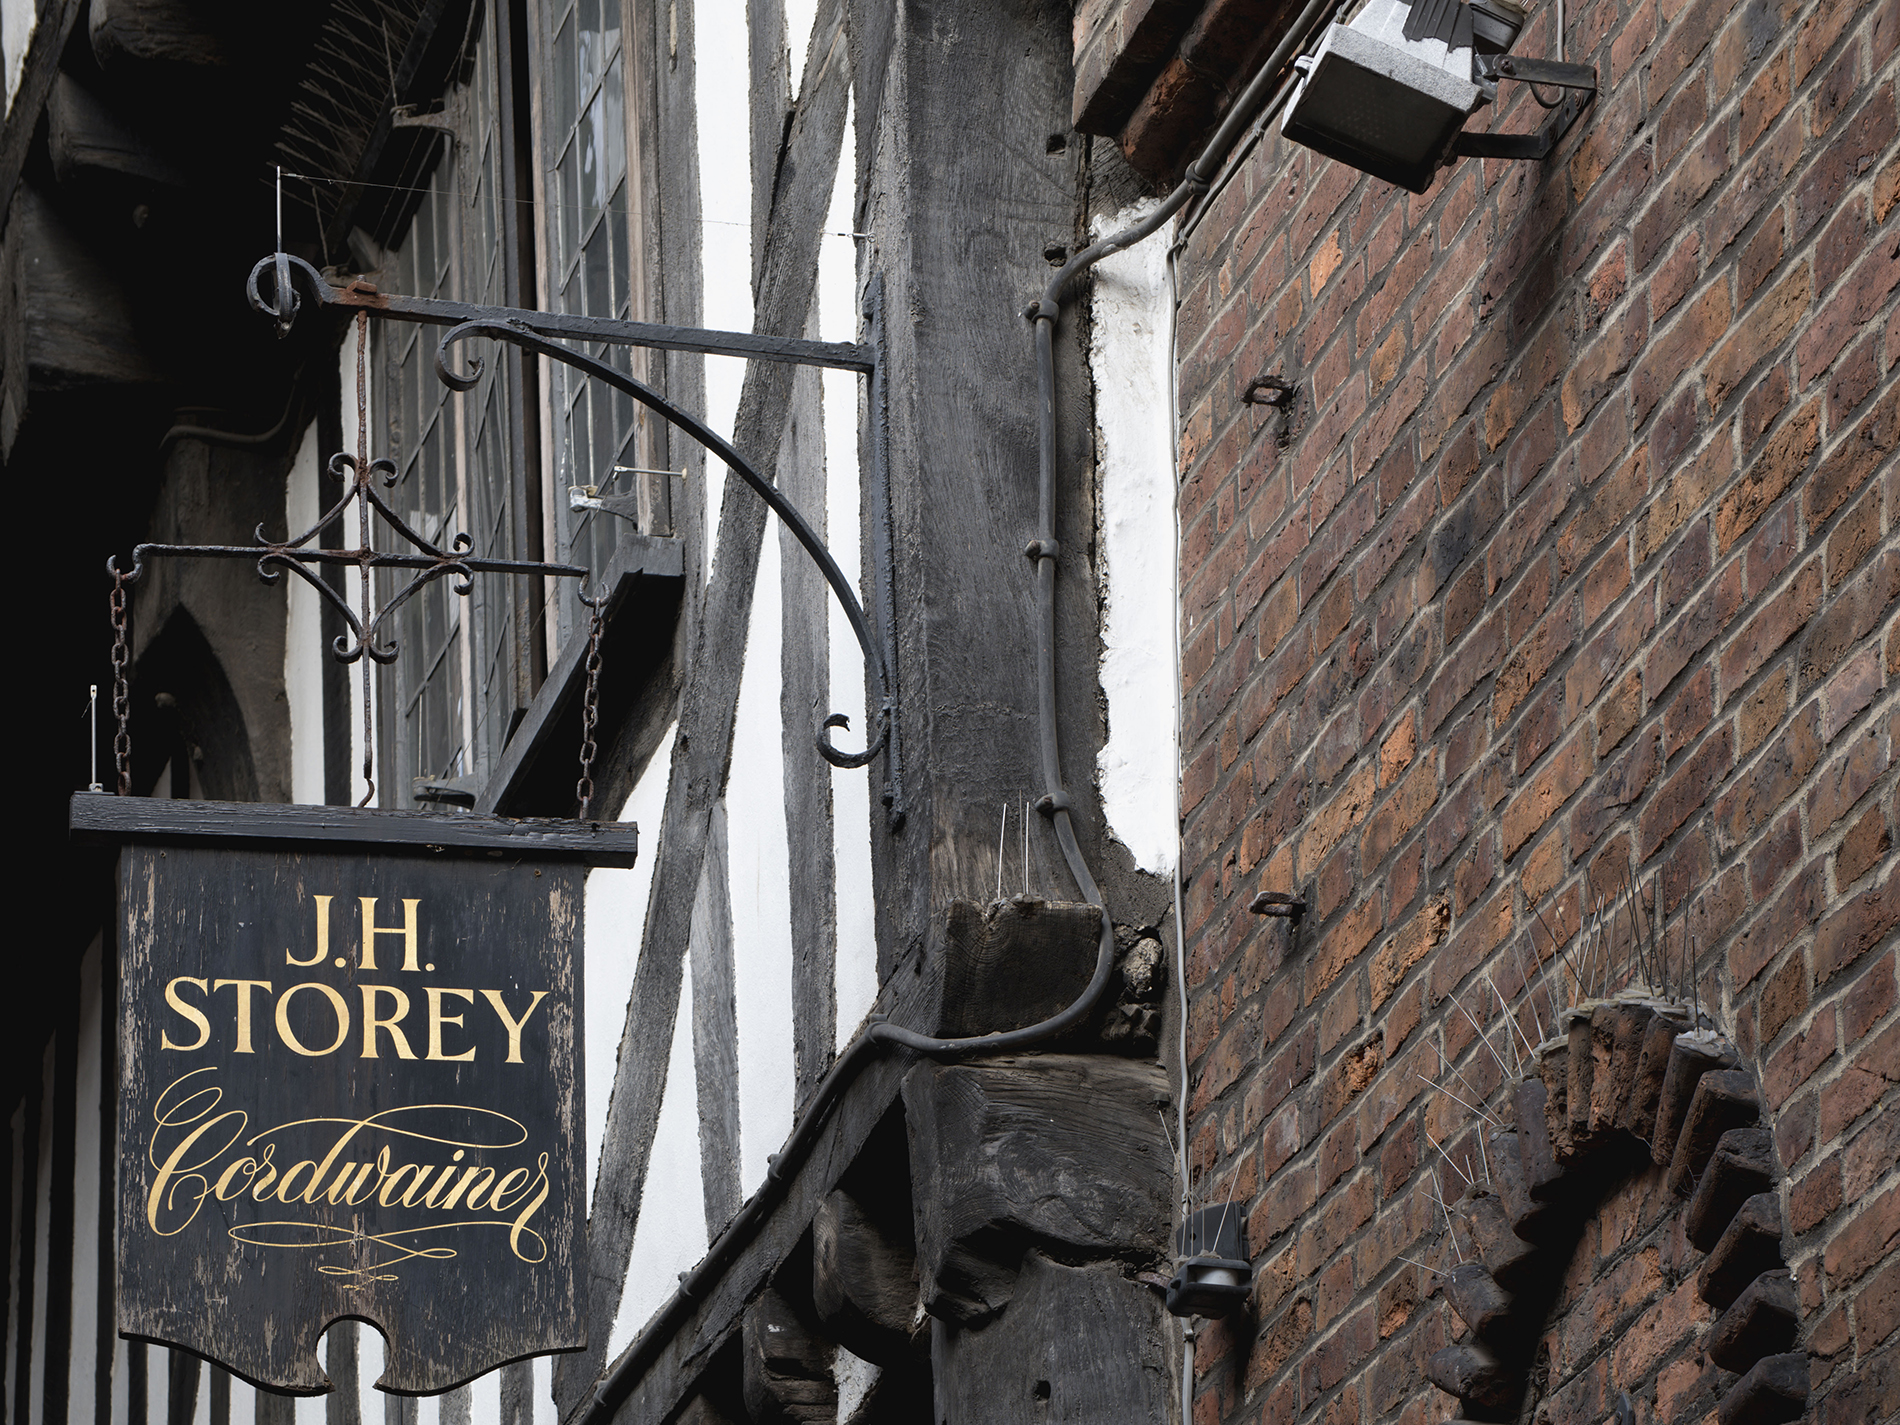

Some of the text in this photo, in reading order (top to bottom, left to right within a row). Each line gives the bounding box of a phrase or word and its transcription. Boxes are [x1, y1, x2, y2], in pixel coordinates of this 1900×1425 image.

[285, 894, 435, 972] J.H.
[160, 976, 549, 1064] STOREY
[147, 1066, 550, 1263] Cordwainer
